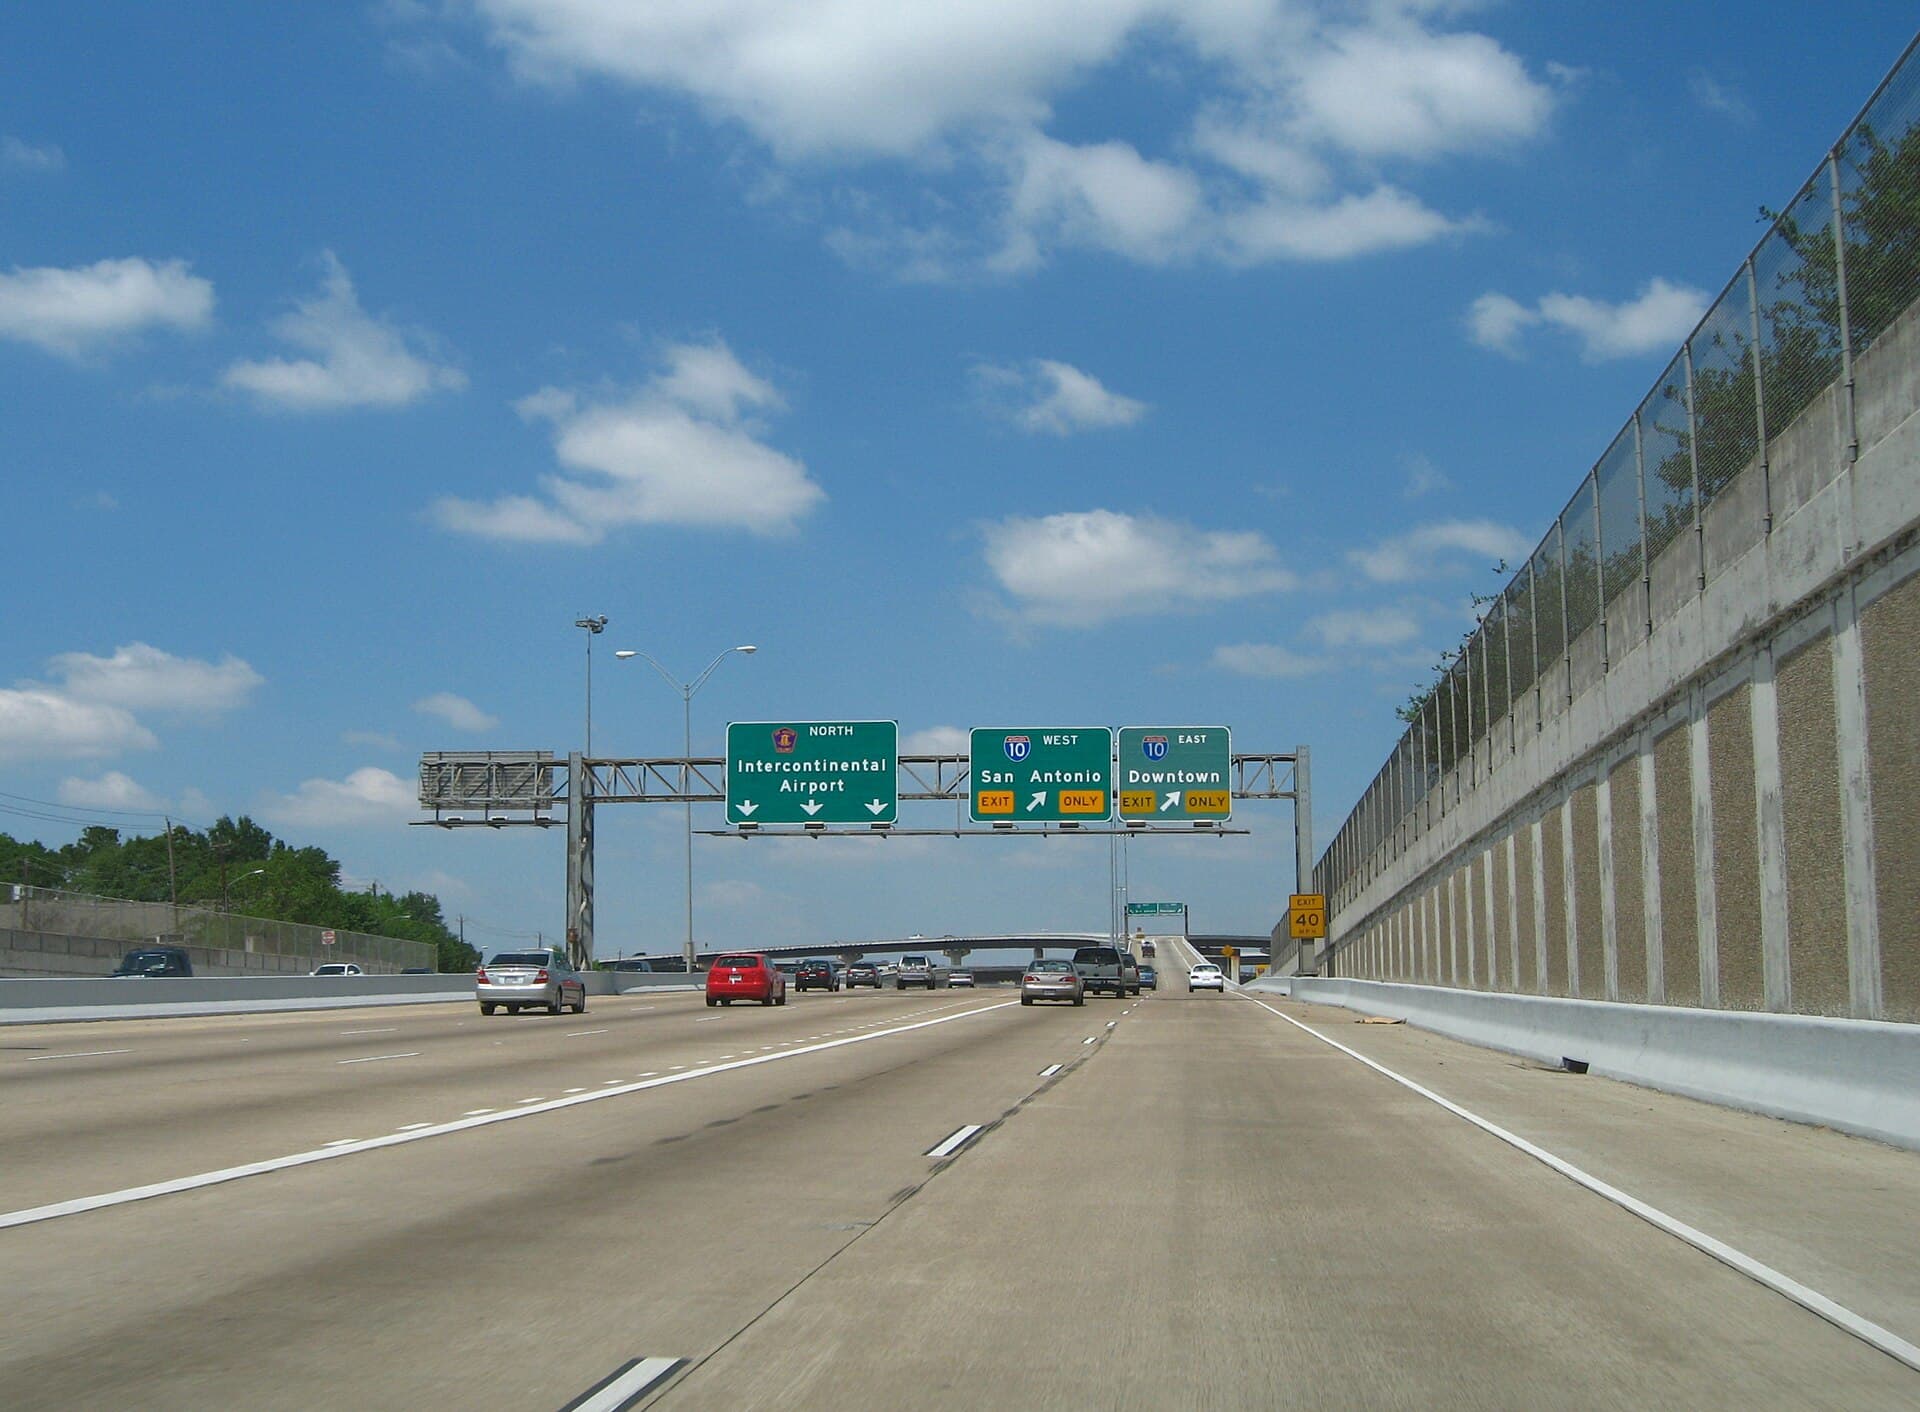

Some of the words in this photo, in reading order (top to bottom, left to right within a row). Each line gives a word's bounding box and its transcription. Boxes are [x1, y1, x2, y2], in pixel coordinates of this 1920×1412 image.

[809, 726, 853, 736] NORTH
[1043, 735, 1078, 745] WEST
[1178, 734, 1207, 744] EAST
[1009, 743, 1025, 757] 10
[1148, 743, 1165, 757] 10
[738, 759, 886, 772] Intercontinental
[981, 770, 1014, 783] San
[1030, 769, 1101, 783] Antonio
[1129, 770, 1220, 783] Downtown
[780, 780, 844, 795] Airport
[981, 796, 1009, 807] EXIT
[1063, 796, 1098, 807] ONLY
[1123, 796, 1152, 807] EXIT
[1188, 796, 1225, 807] ONLY
[1295, 913, 1319, 926] 40
